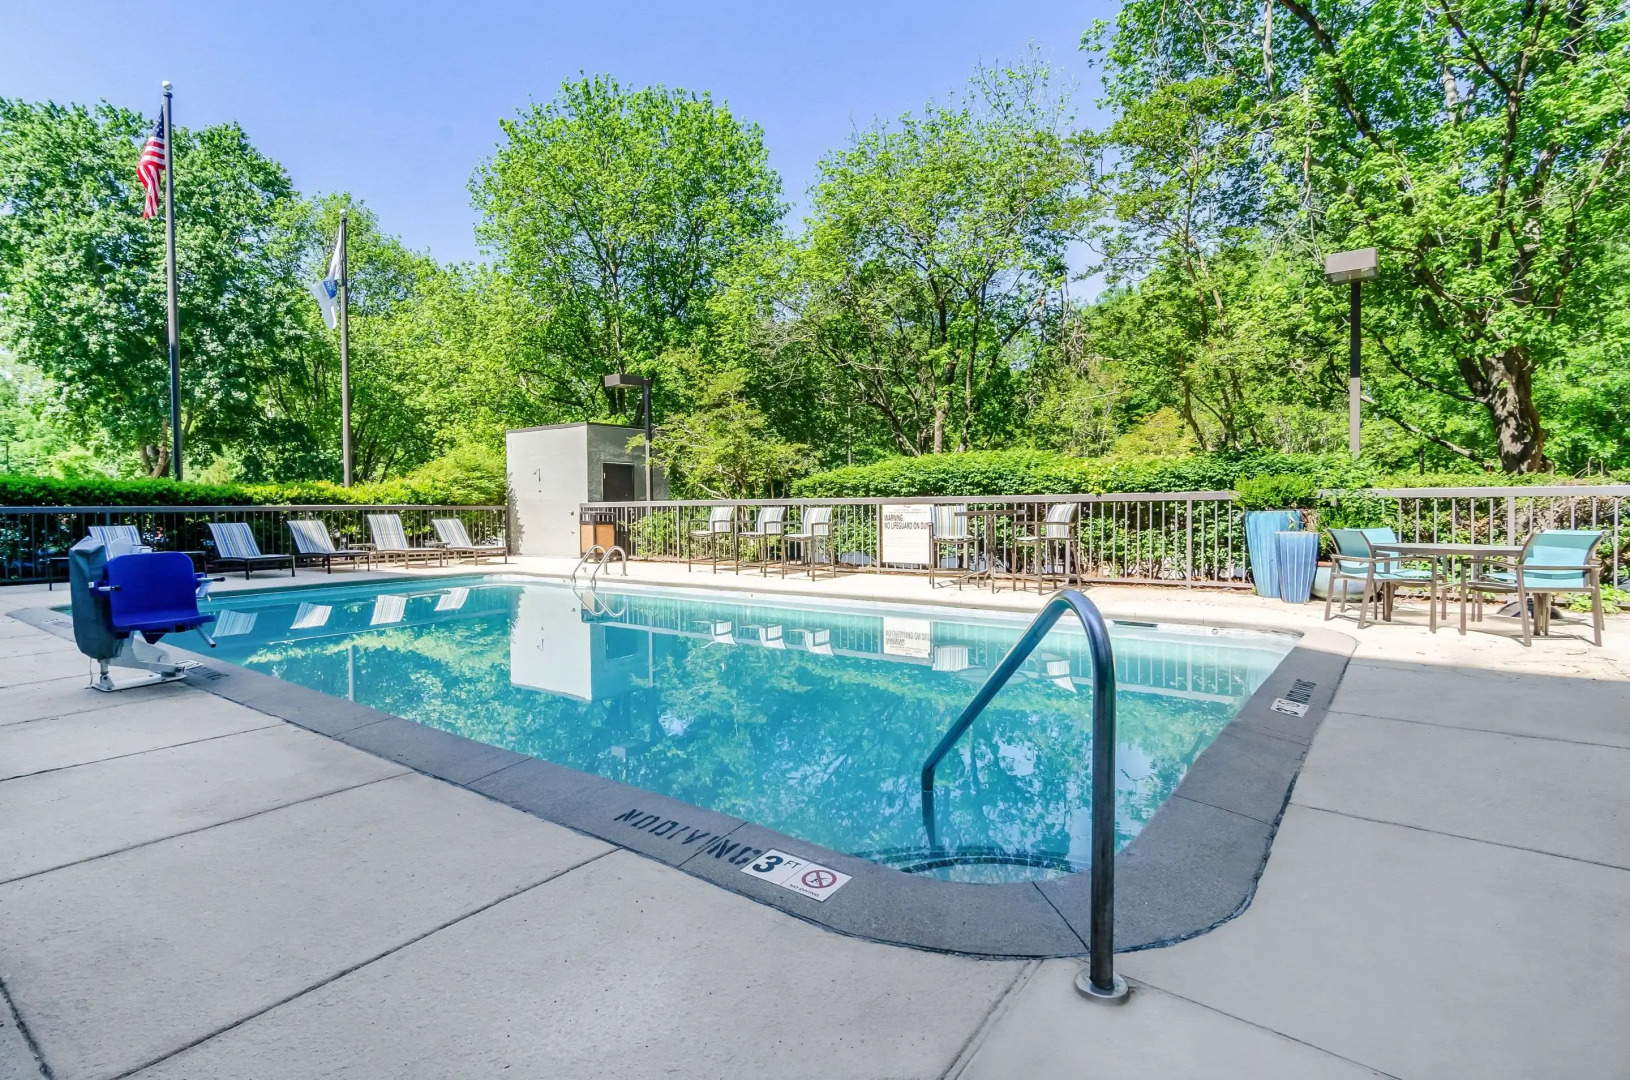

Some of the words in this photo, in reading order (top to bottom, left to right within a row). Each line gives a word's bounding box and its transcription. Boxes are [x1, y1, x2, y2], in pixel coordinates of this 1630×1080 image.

[891, 522, 912, 530] LIFEGUARD
[752, 855, 784, 873] 3
[783, 860, 803, 869] FT
